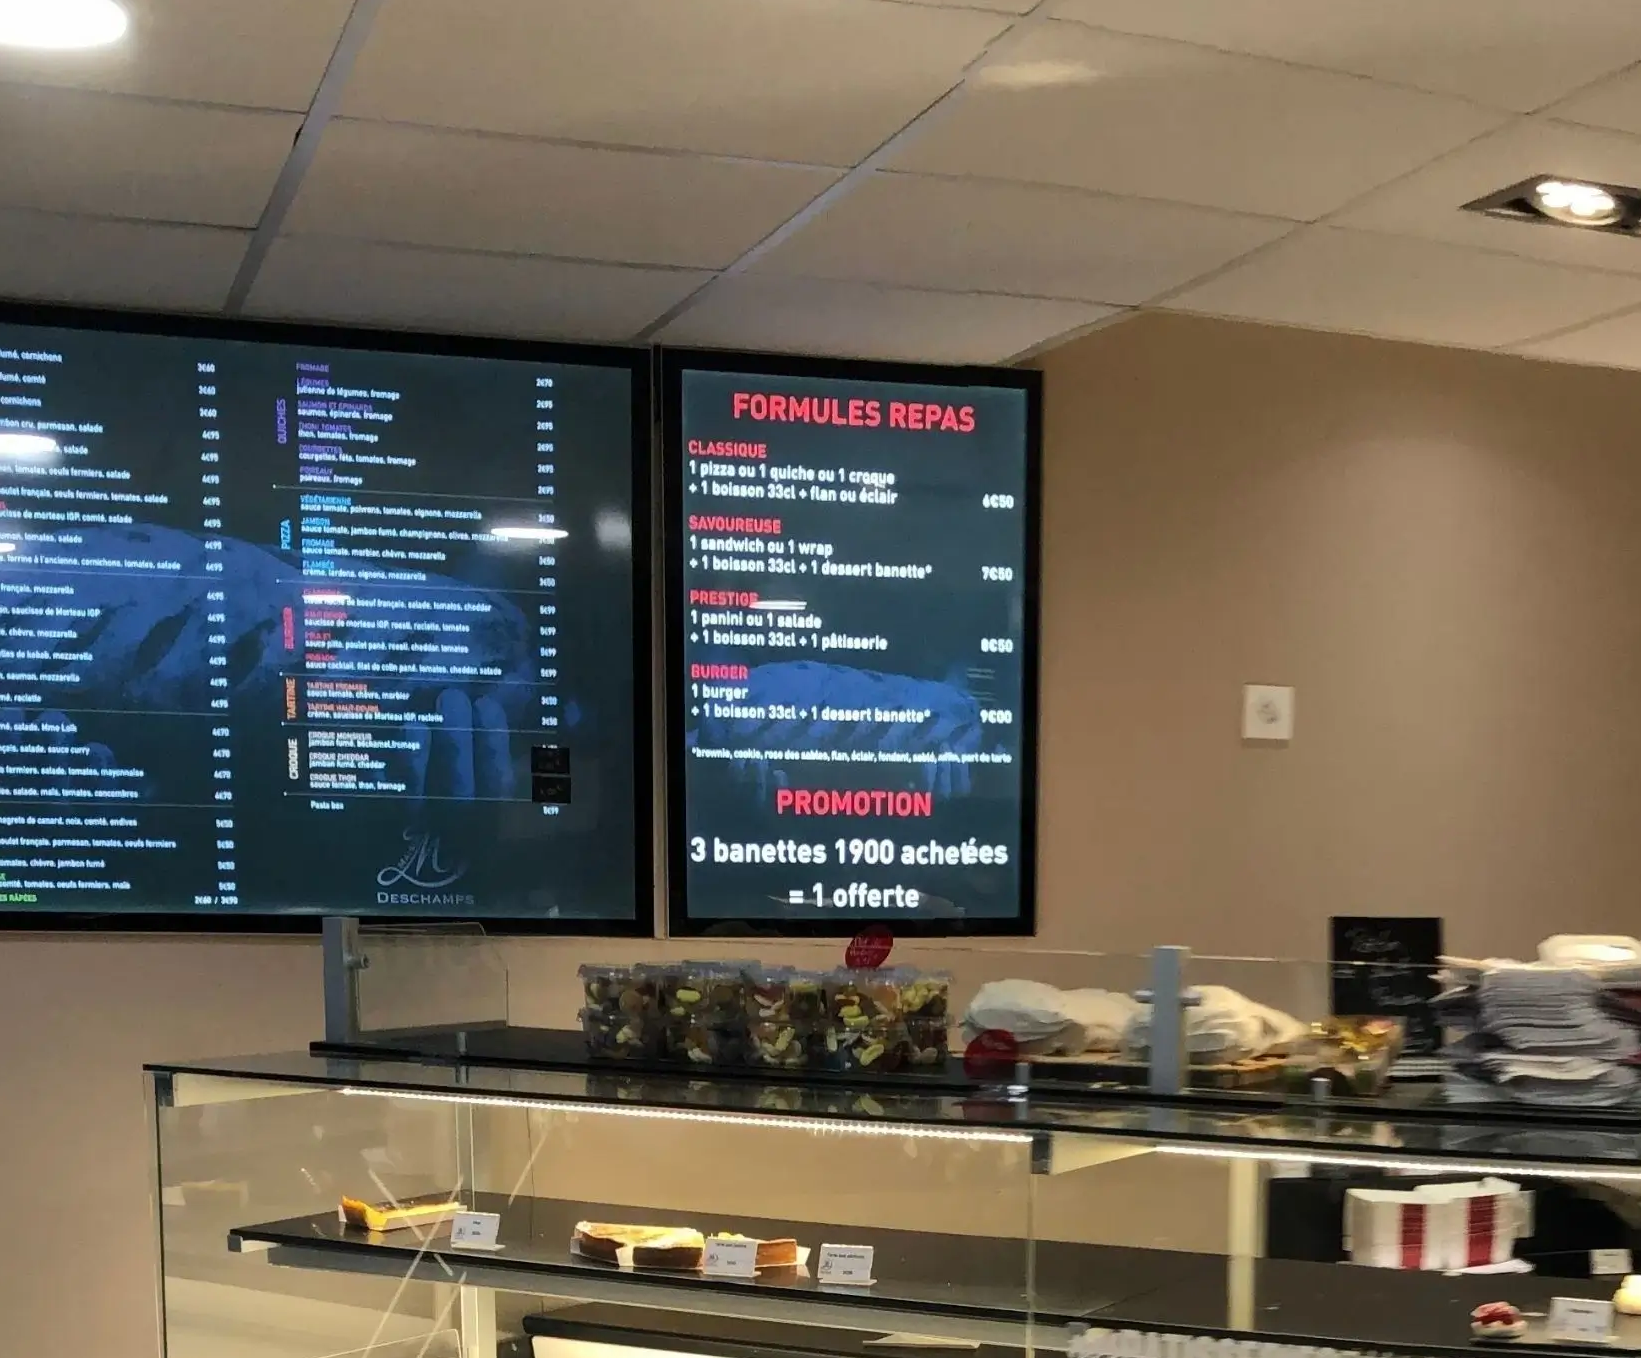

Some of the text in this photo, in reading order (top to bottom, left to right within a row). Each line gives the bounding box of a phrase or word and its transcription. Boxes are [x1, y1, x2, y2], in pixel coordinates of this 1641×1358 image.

[733, 393, 975, 431] FORMULES REPAS
[688, 440, 766, 458] CLASSIQUE
[689, 459, 895, 488] 1 pizza ou 1 quiche ou 1 croque
[700, 479, 708, 495] 1
[711, 481, 765, 498] boisson
[767, 483, 796, 499] 33cl
[809, 485, 837, 501] flan
[839, 489, 857, 503] ou
[858, 486, 898, 504] éclair
[689, 516, 781, 533] SAVOUREUSE
[689, 534, 833, 558] 1 sandwich ou 1 wrap
[701, 554, 708, 570] 1
[712, 555, 765, 572] boisson
[767, 557, 796, 574] 33cl
[810, 559, 817, 574] 1
[821, 560, 872, 576] dessert
[690, 609, 822, 629] 1 panini ou 1 salade
[702, 628, 709, 644] 1
[713, 630, 765, 646] boisson
[767, 631, 796, 647] 33cl
[810, 632, 817, 648] 1
[821, 633, 888, 650] pâtisserie
[691, 664, 748, 679] BURGER
[691, 683, 749, 702] 1 burger
[703, 702, 710, 717] 1
[713, 703, 766, 719] boisson
[768, 704, 797, 720] 33cl
[810, 705, 817, 720] 1
[821, 706, 872, 722] dessert
[777, 790, 931, 816] PROMOTION
[690, 836, 706, 862] 3
[713, 838, 827, 863] banettes
[834, 838, 894, 864] 1900
[812, 882, 823, 907] 1
[832, 882, 920, 908] offerte
